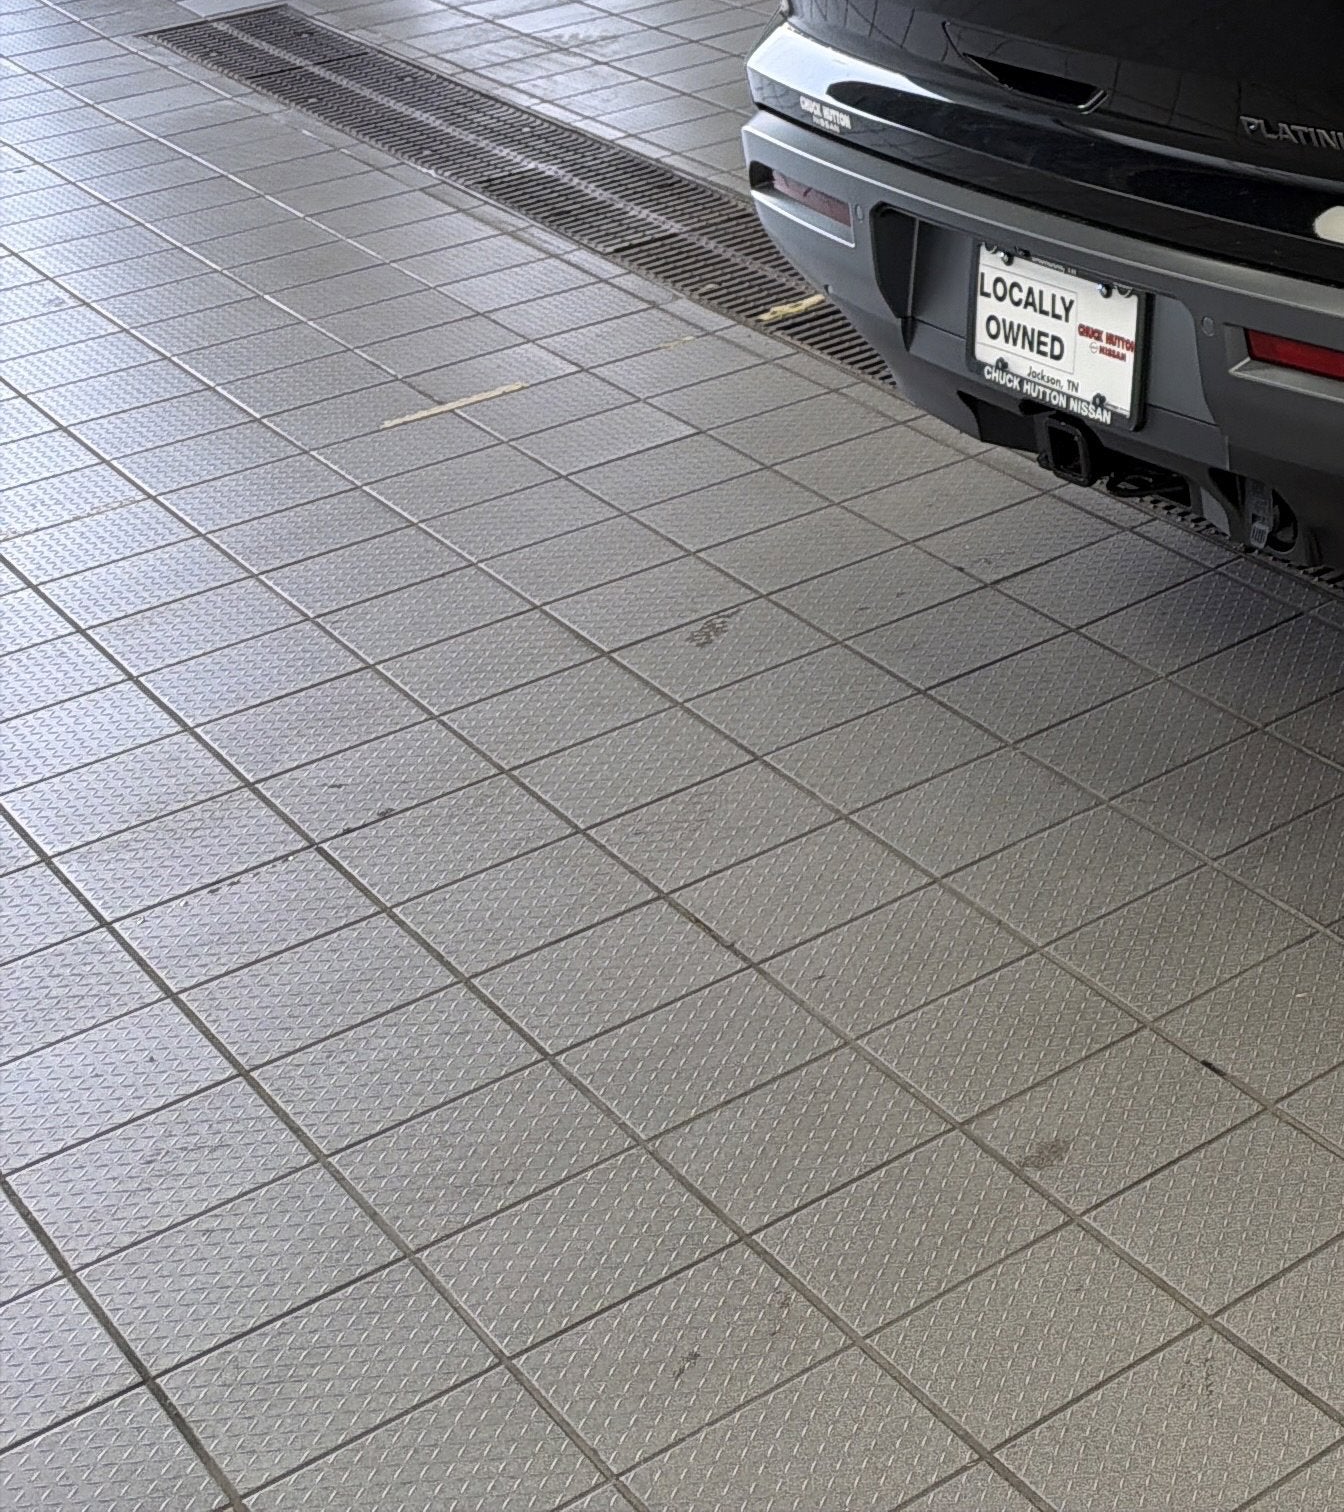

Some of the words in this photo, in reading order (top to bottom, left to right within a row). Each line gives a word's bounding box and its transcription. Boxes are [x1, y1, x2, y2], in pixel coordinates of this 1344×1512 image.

[979, 272, 1074, 323] LOCALLY
[985, 314, 1065, 361] OWNED
[1078, 323, 1104, 343] CHUCK
[1105, 332, 1136, 353] HUTTON
[1099, 345, 1127, 362] NISSAN
[984, 365, 1021, 391] CHUCK
[1023, 379, 1067, 409] HUTTON
[1069, 398, 1111, 425] NISSAN
[1027, 365, 1064, 389] Jackson,
[1066, 379, 1080, 394] TN
